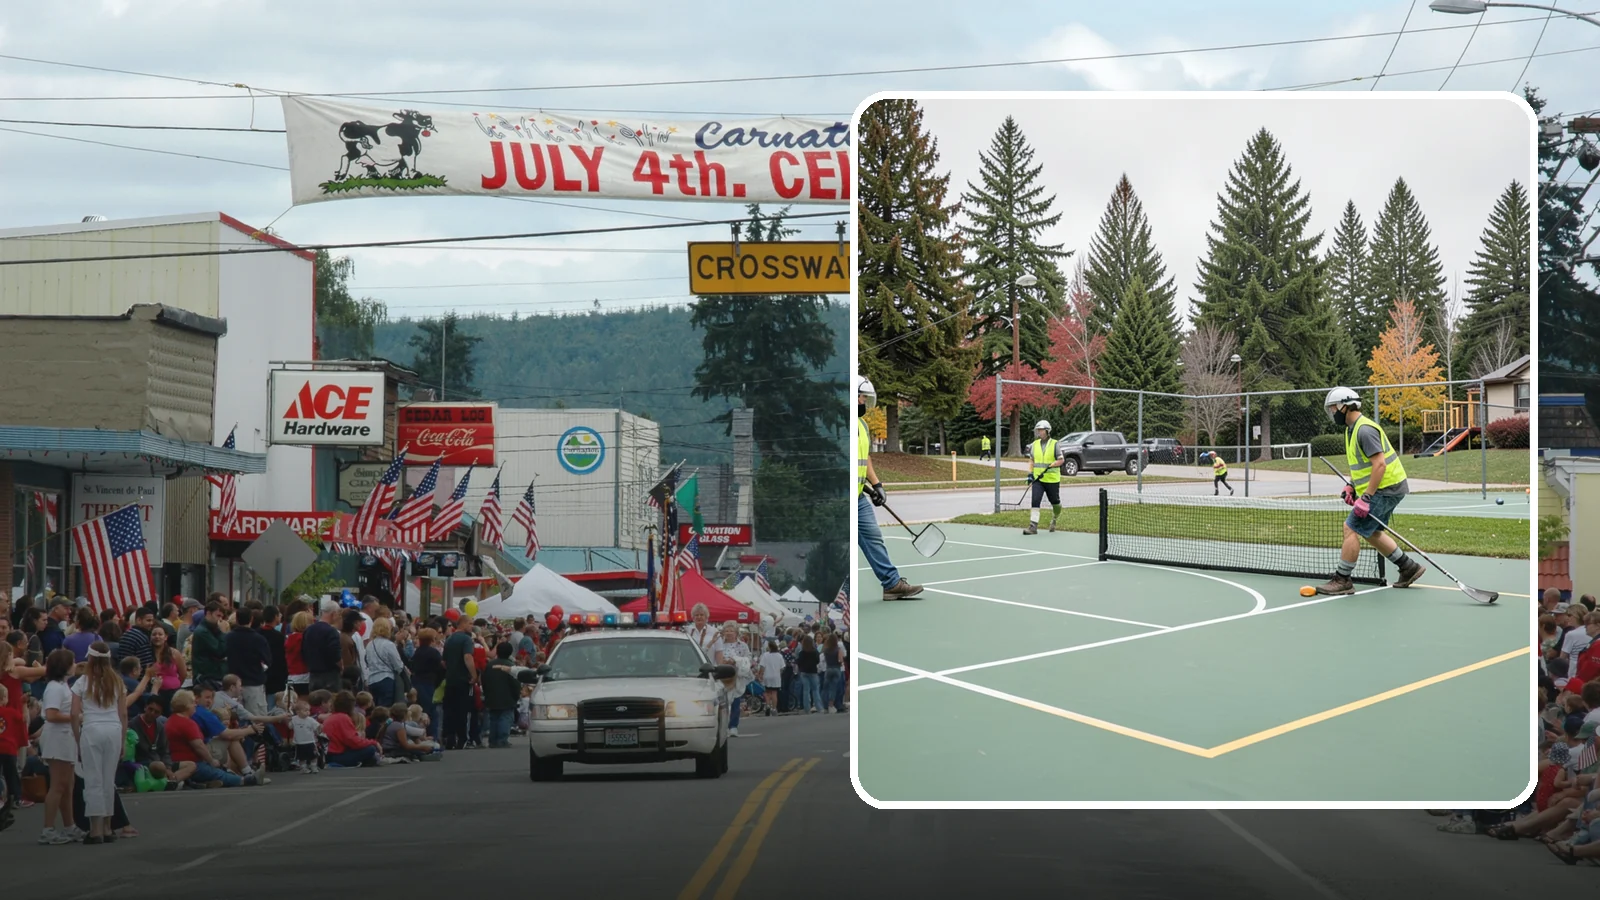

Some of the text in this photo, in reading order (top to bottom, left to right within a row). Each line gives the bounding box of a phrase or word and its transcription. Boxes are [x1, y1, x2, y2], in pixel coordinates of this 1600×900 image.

[481, 141, 604, 192] JULY
[632, 150, 746, 197] 4th.
[283, 380, 373, 420] ACE
[406, 409, 452, 421] CEDAR
[283, 421, 370, 436] Hardware
[353, 467, 383, 480] Simpl
[83, 485, 155, 495] St. Vincent de Paul
[213, 516, 330, 535] HARDARE
[688, 526, 741, 535] CRNATION
[699, 535, 730, 543] GLASS
